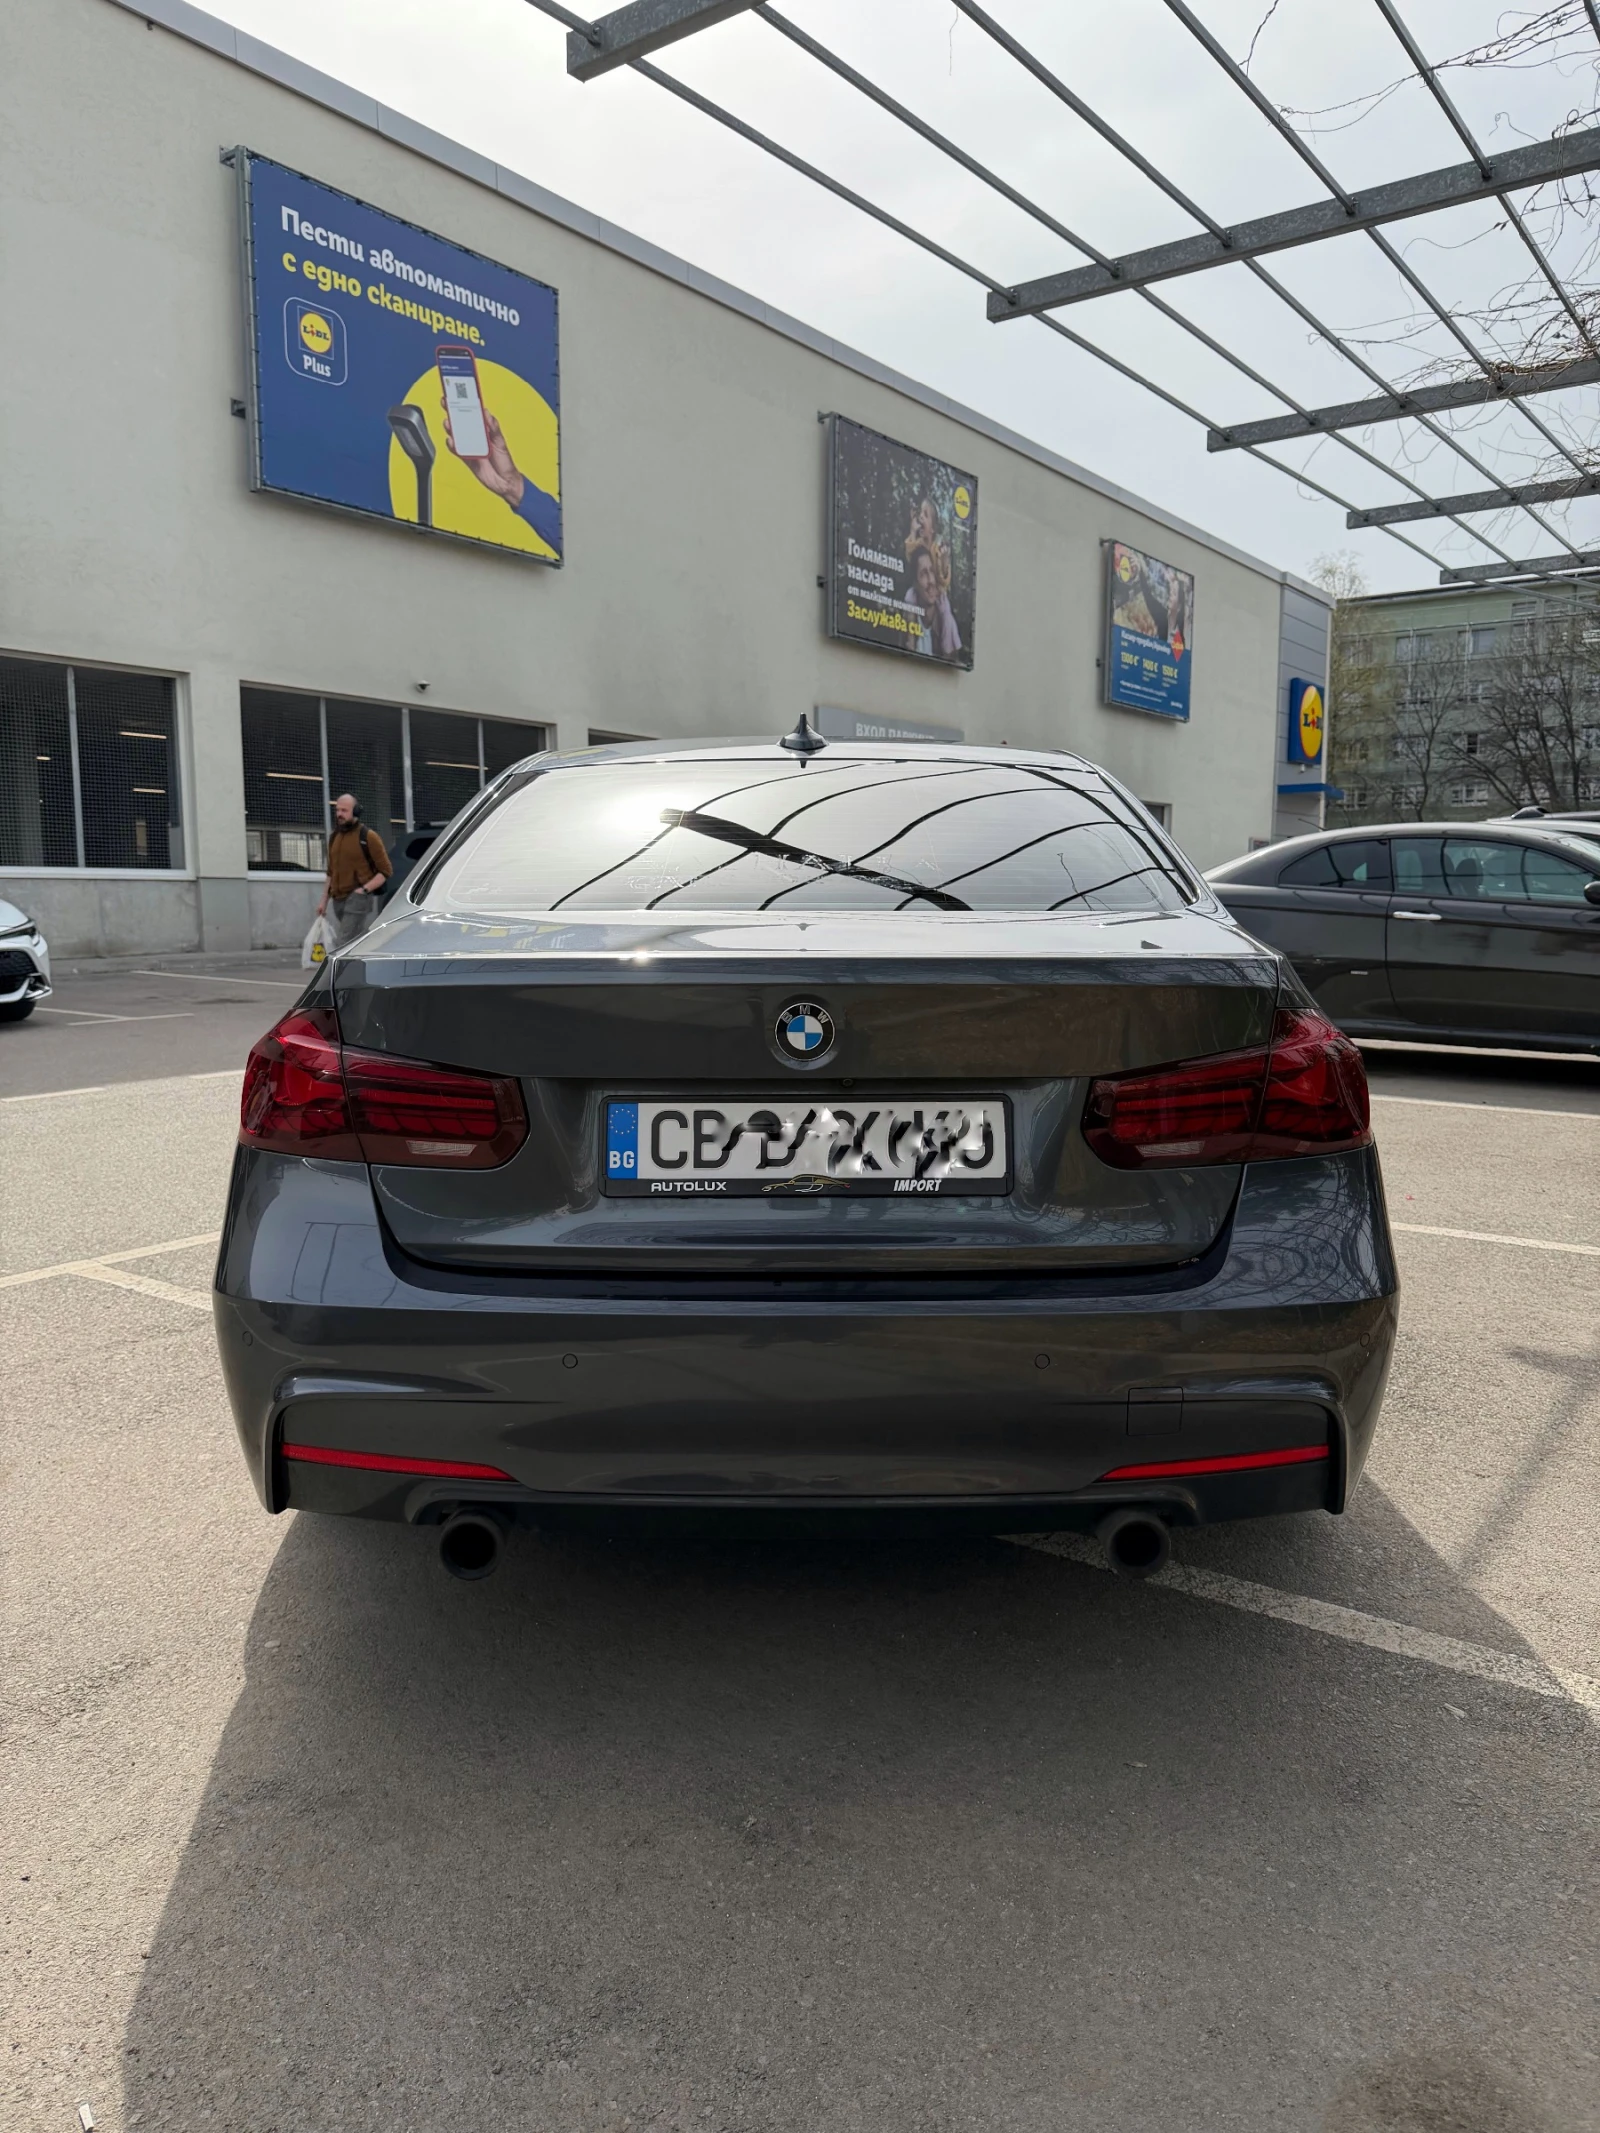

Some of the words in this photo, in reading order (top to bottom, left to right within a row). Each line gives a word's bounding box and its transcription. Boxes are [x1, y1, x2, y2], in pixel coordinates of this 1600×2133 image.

[281, 205, 364, 262] Пести
[369, 249, 520, 327] автоматично
[282, 252, 297, 273] с
[302, 259, 362, 297] едно
[367, 284, 485, 347] сканиране.
[302, 354, 331, 378] Plus
[847, 538, 905, 573] Голямата
[847, 564, 895, 593] наслада
[847, 599, 907, 632] Заслужава
[781, 1005, 830, 1024] BMW
[609, 1150, 635, 1169] BG
[651, 1181, 727, 1192] AUTOLUX
[893, 1179, 942, 1192] IMPORT
